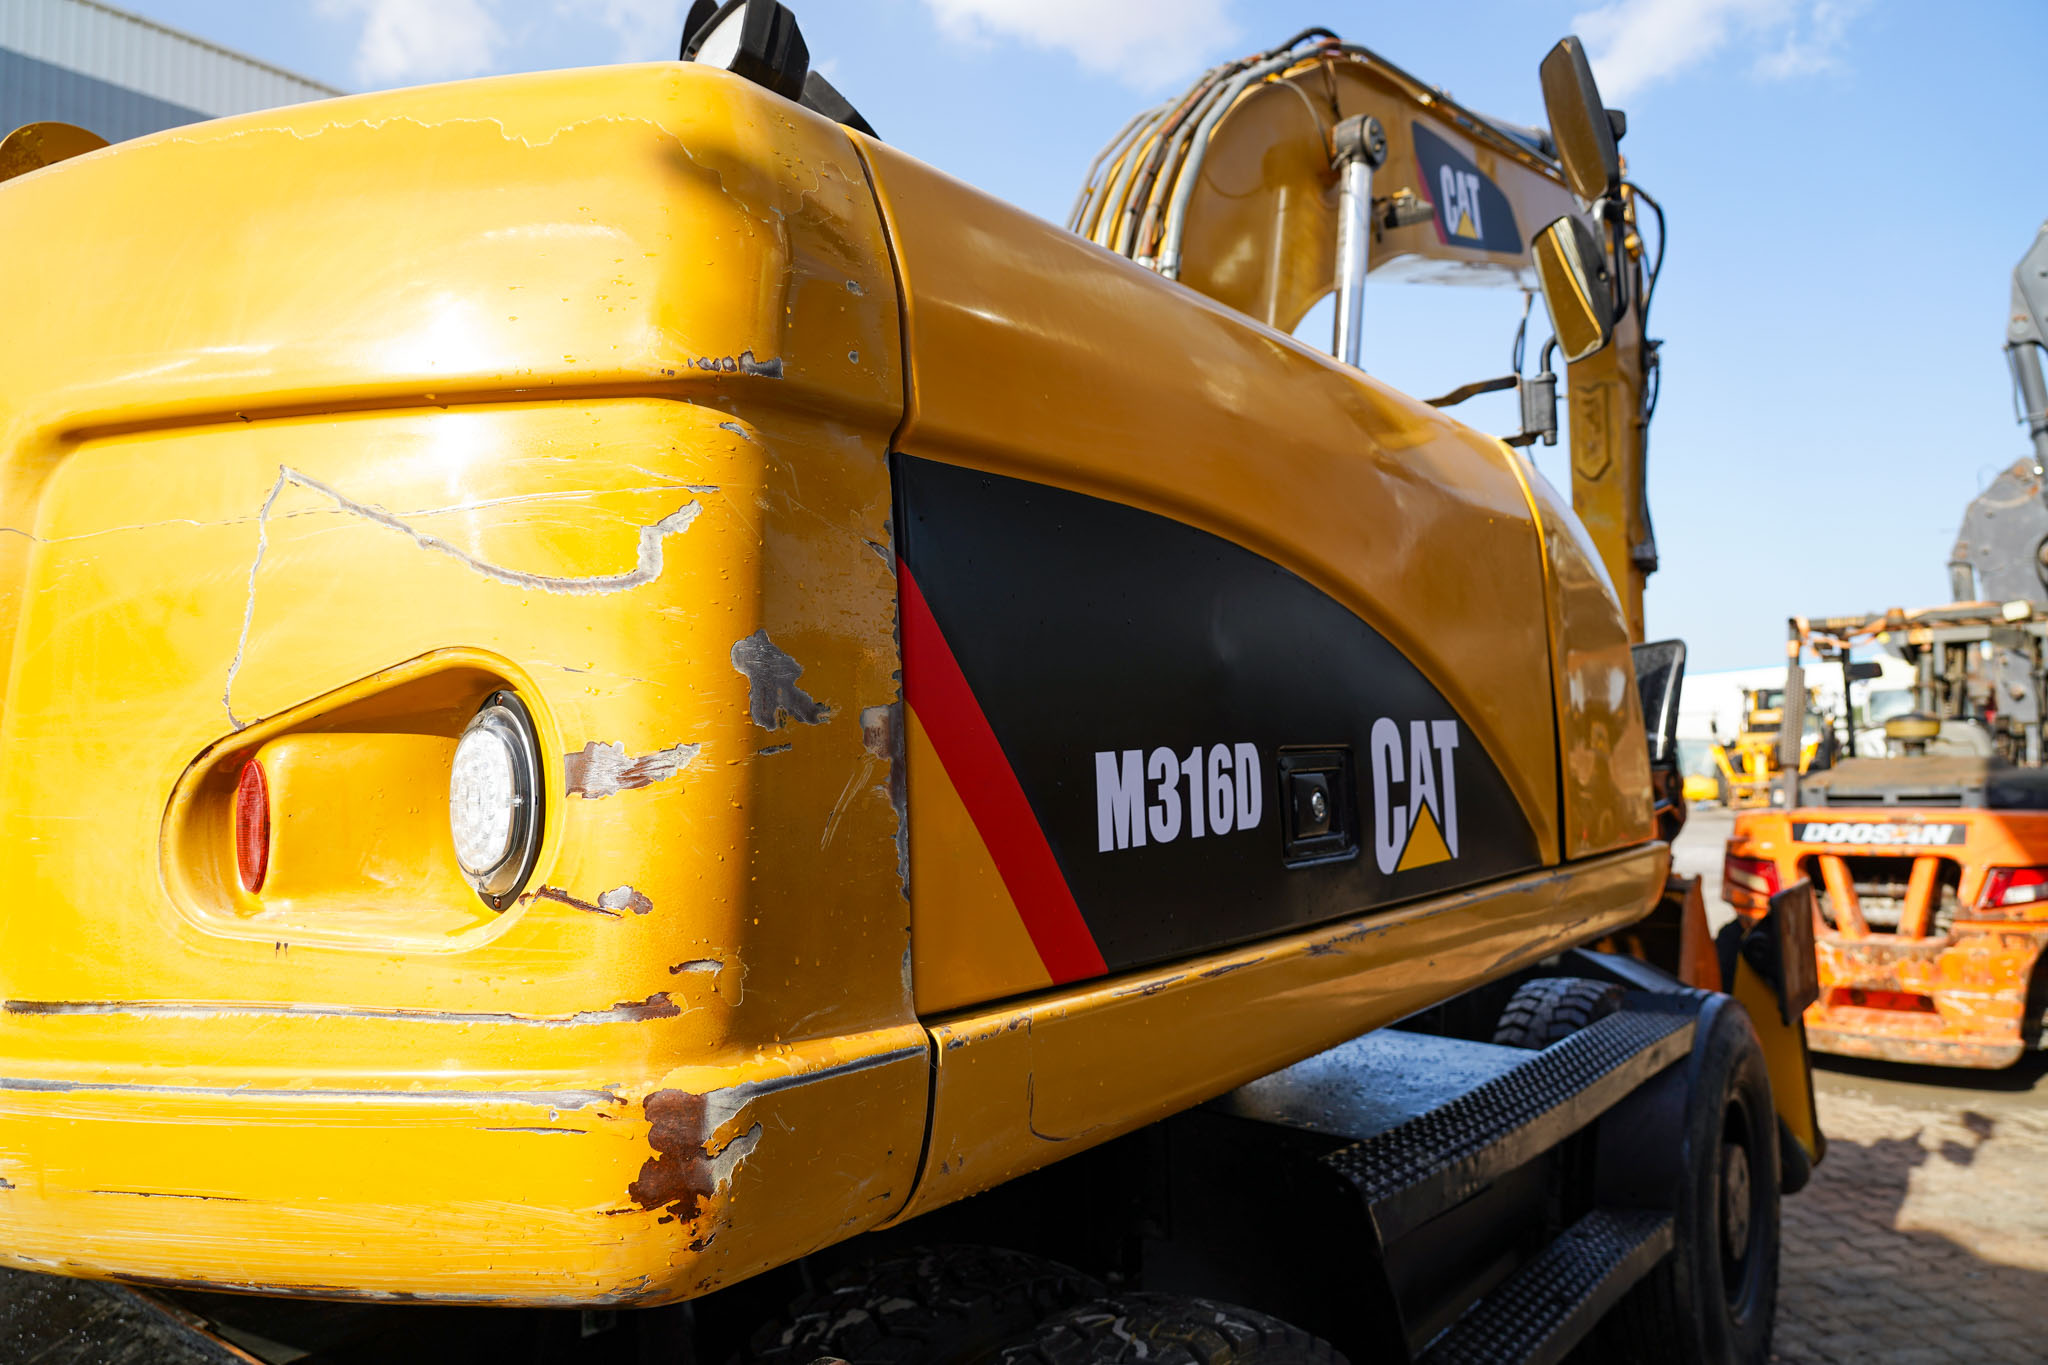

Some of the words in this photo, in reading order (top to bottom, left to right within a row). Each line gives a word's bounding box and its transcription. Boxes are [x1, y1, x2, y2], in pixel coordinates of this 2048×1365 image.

[1440, 164, 1483, 240] CAT
[1095, 742, 1262, 853] M316D
[1370, 717, 1460, 875] CAT
